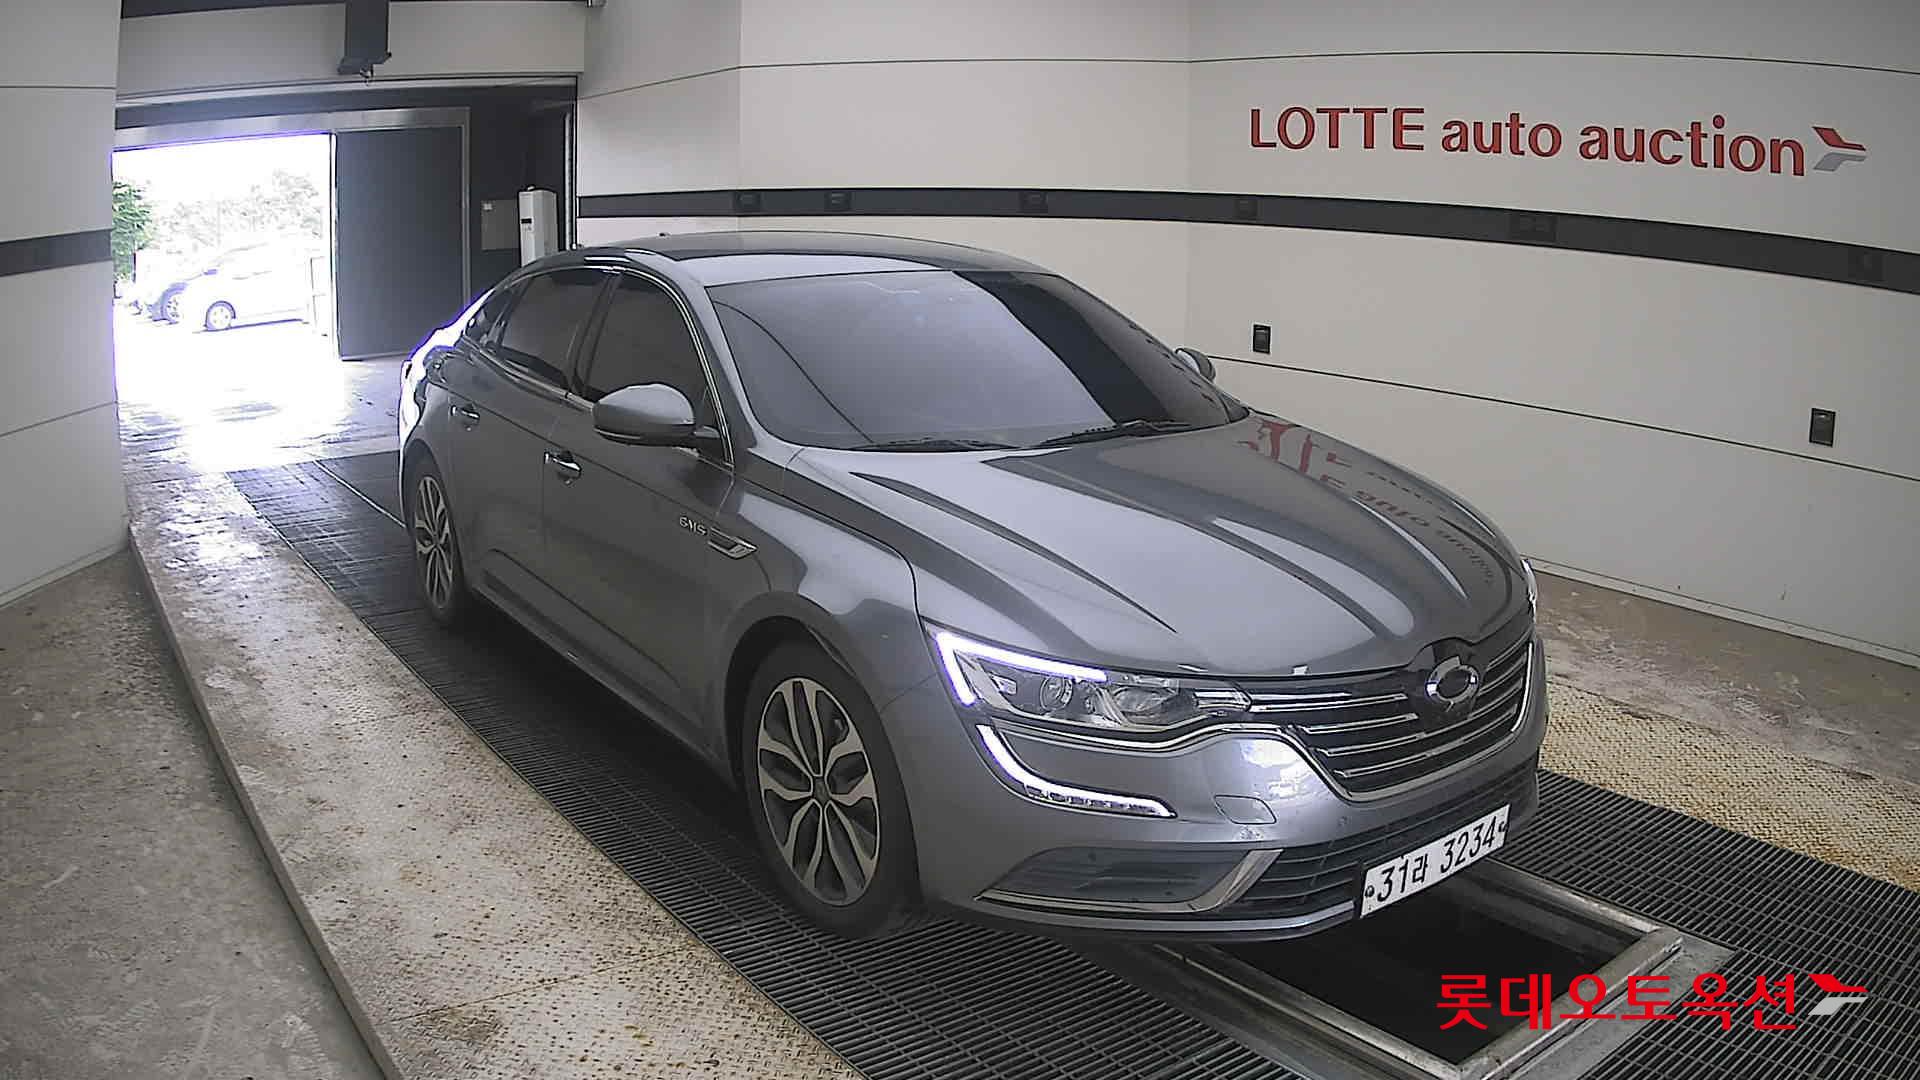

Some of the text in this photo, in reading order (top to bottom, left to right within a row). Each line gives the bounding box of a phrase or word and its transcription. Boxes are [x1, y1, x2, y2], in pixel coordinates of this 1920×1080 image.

[1250, 107, 1805, 176] LOTTE auto auction
[1376, 816, 1497, 902] 31라 3234
